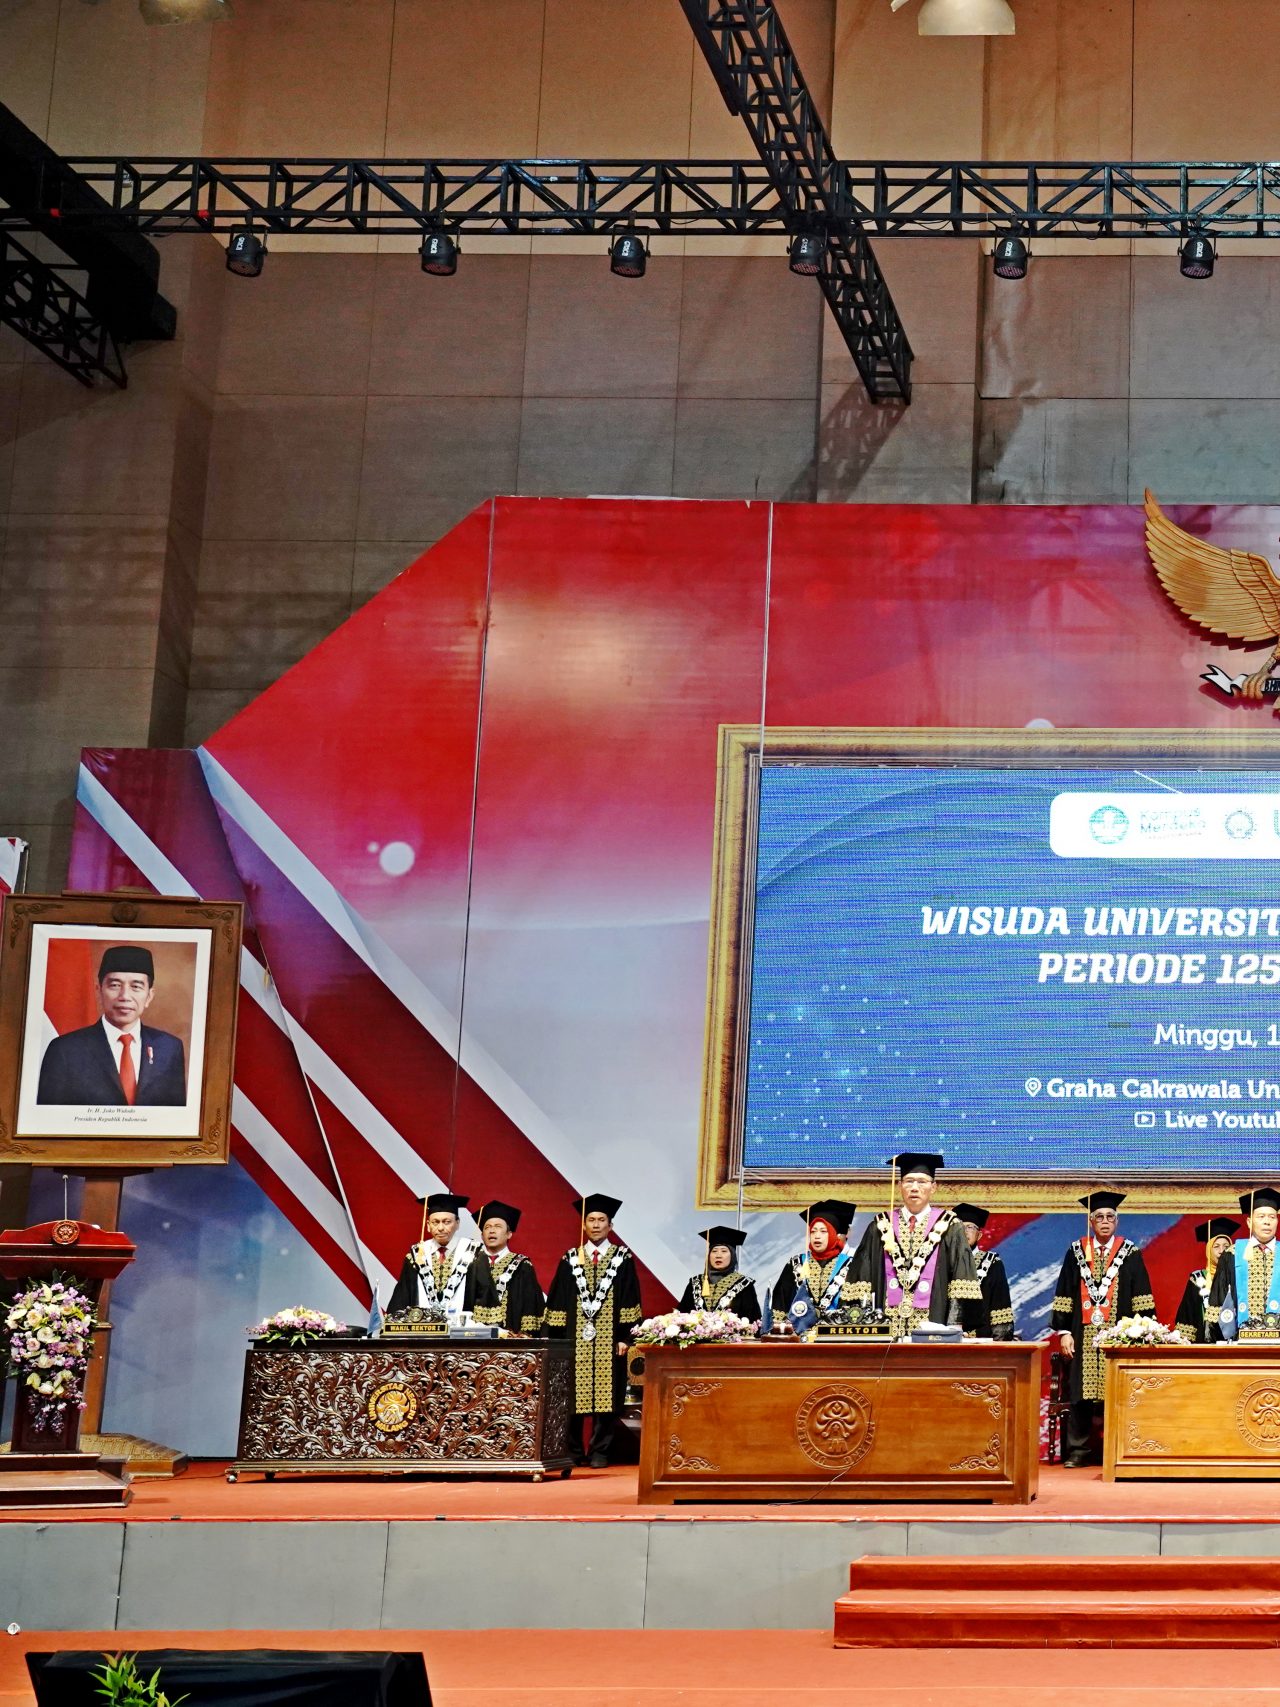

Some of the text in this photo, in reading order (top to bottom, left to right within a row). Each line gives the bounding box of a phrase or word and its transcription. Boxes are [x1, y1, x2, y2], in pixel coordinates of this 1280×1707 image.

[921, 906, 1071, 935] WISUDA
[1038, 952, 1206, 984] PERIODE
[1153, 1023, 1258, 1051] Minggu,
[1047, 1078, 1117, 1098] Graha
[1122, 1078, 1241, 1099] Cakrawala
[1165, 1111, 1208, 1128] Live
